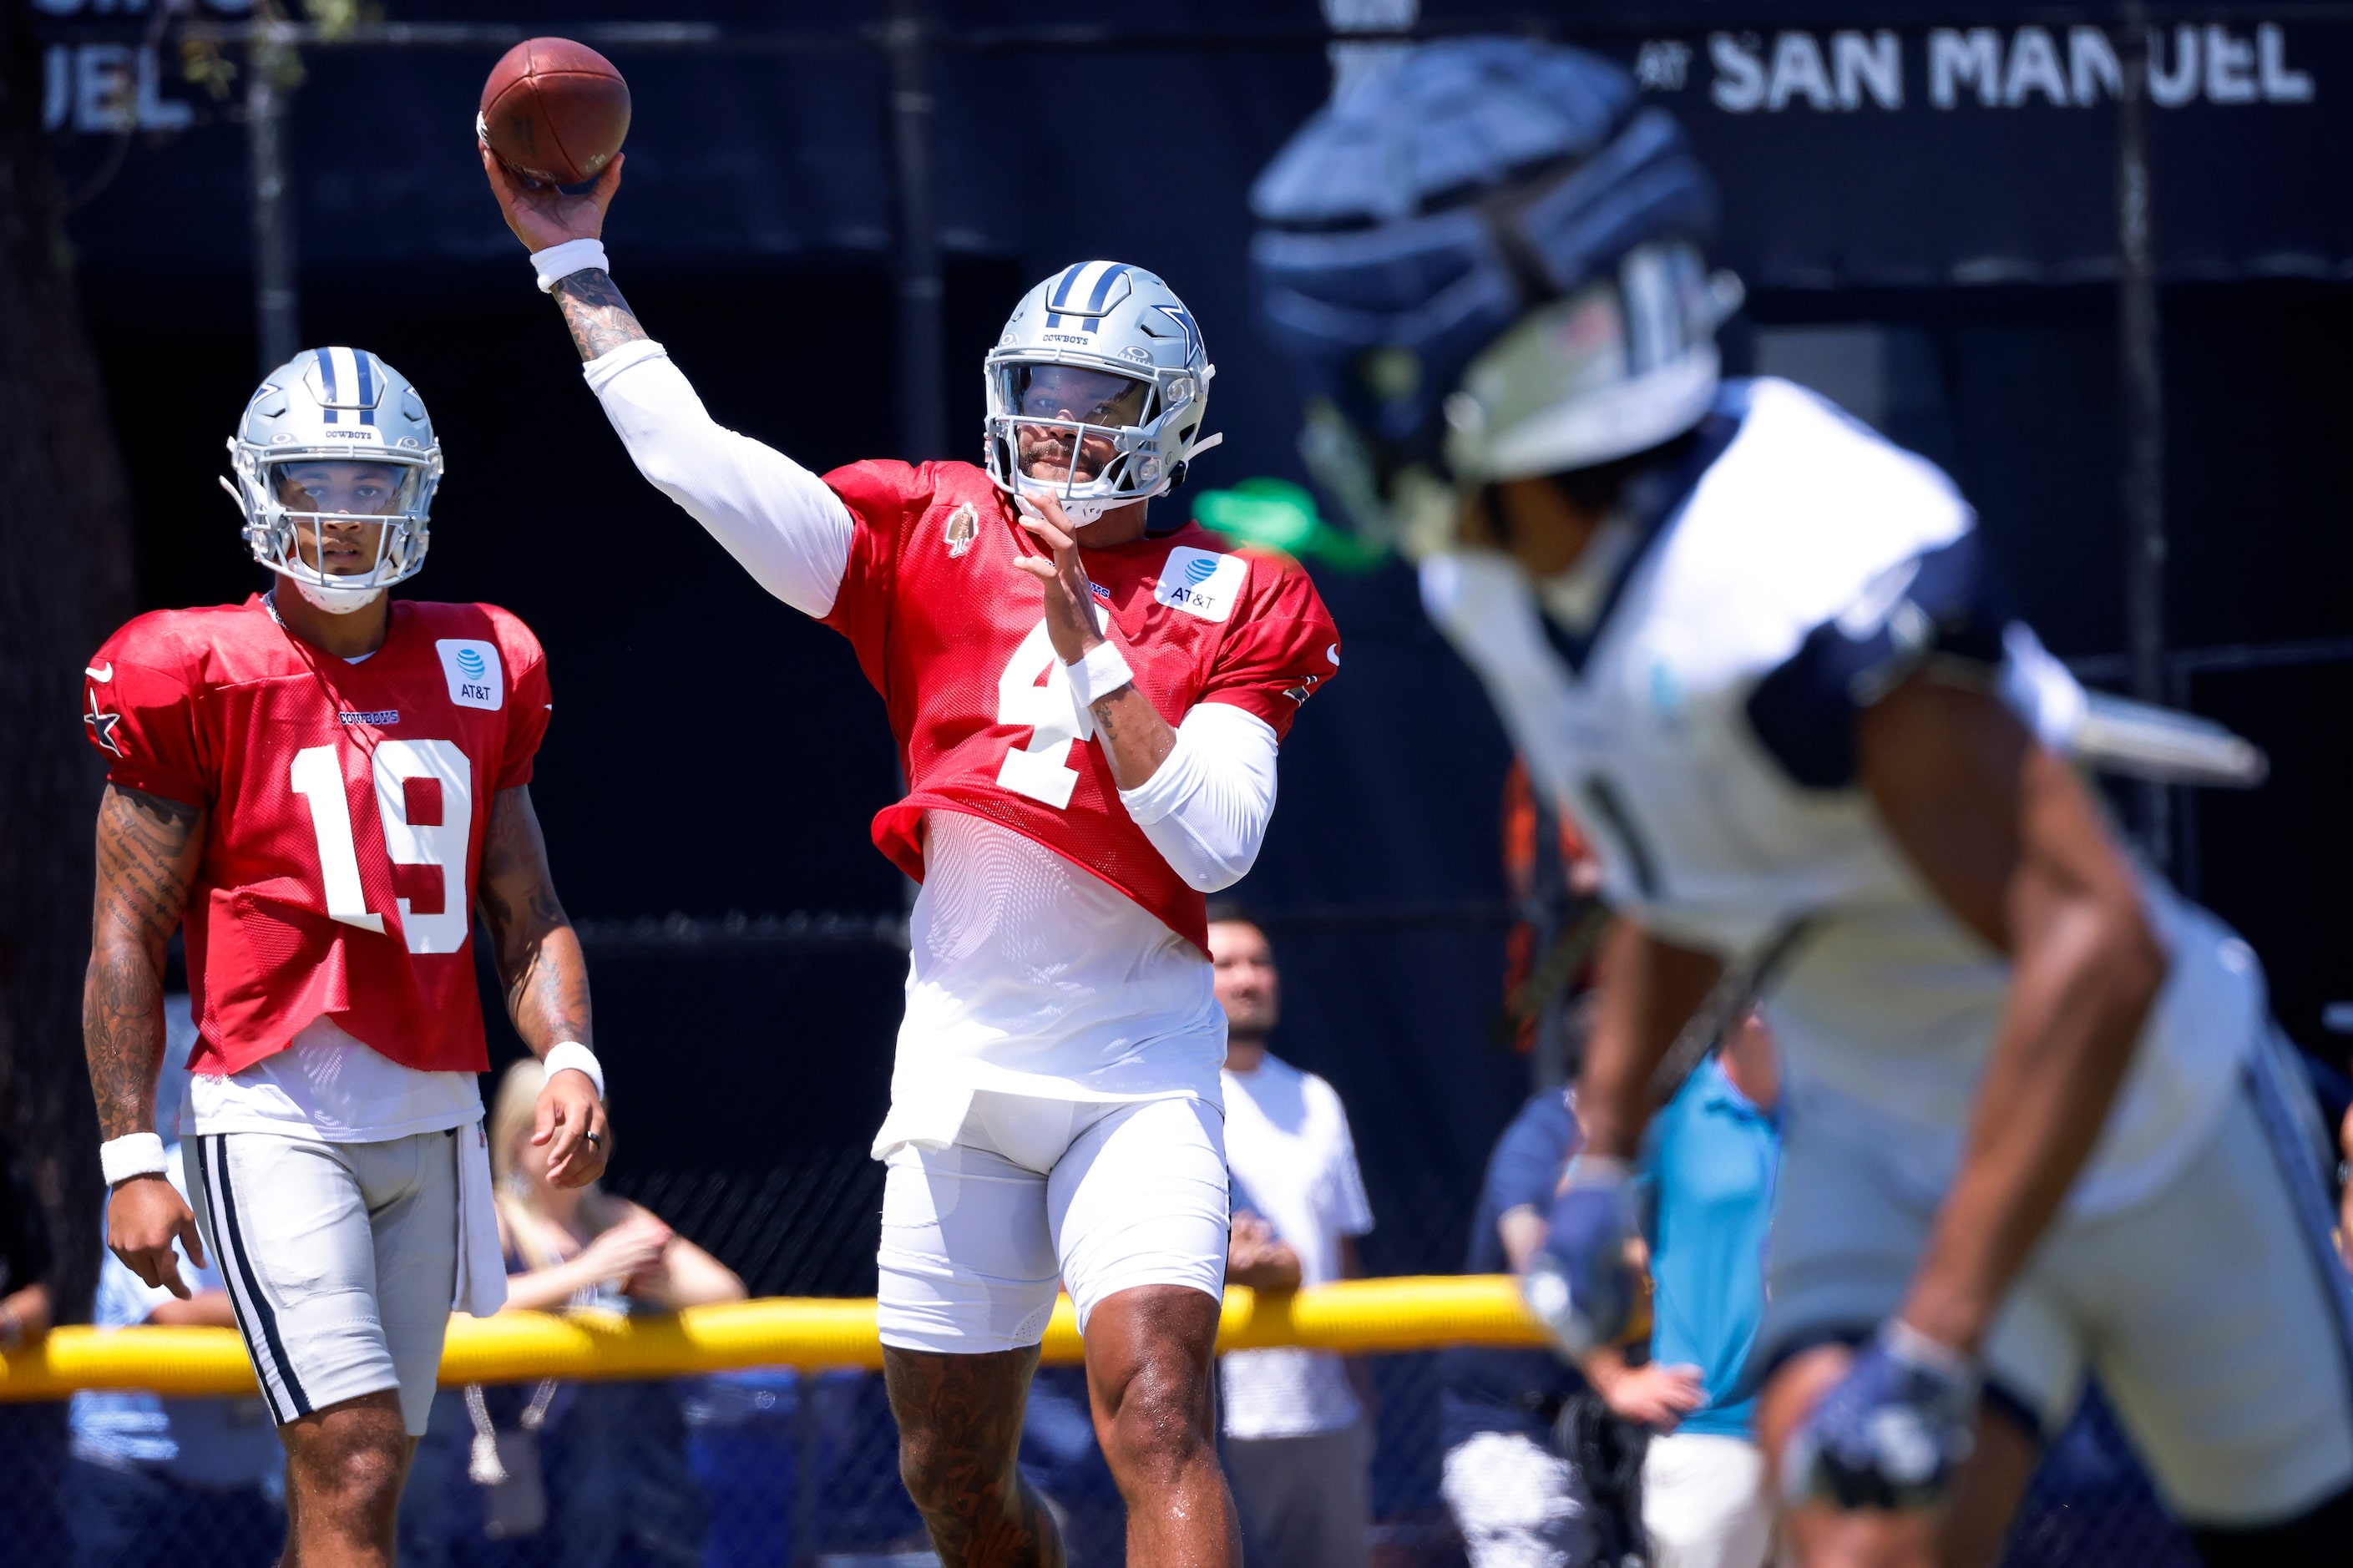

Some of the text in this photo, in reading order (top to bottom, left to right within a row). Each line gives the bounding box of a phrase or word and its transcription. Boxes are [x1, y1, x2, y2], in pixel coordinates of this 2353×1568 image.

[1708, 30, 1903, 112] SAN
[1930, 23, 2315, 108] MANUEL
[1043, 334, 1088, 345] COWBOYS
[326, 430, 372, 439] COWBOYS
[1171, 587, 1216, 609] AT&T
[461, 684, 490, 700] AT&T
[995, 603, 1110, 810] 4
[339, 710, 399, 725] COWBOYS
[291, 739, 473, 954] 19
